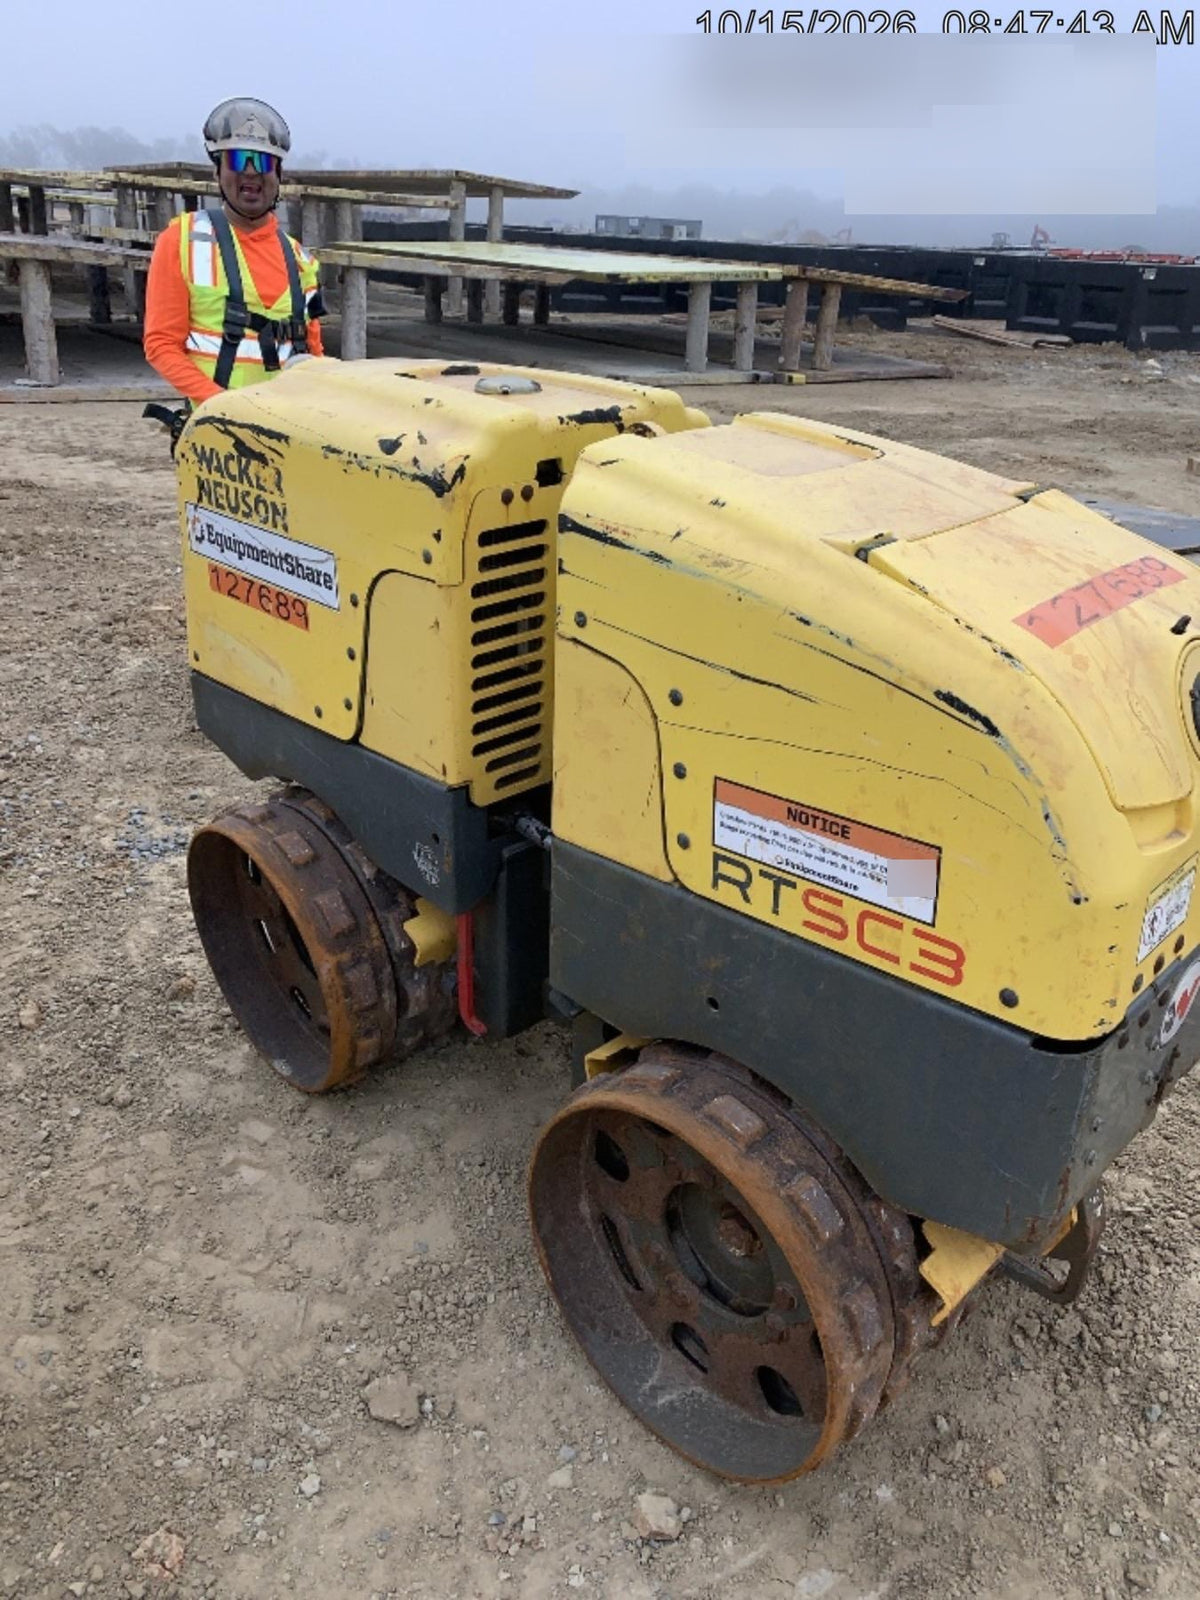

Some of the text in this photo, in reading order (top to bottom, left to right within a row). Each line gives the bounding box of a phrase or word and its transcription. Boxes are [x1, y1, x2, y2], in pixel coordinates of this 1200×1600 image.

[191, 442, 284, 497] WACKER
[196, 475, 289, 533] NEUSON
[206, 523, 334, 591] EquipmentShare
[211, 566, 310, 630] 127689
[787, 807, 851, 840] NOTICE
[711, 852, 966, 987] RTSC3
